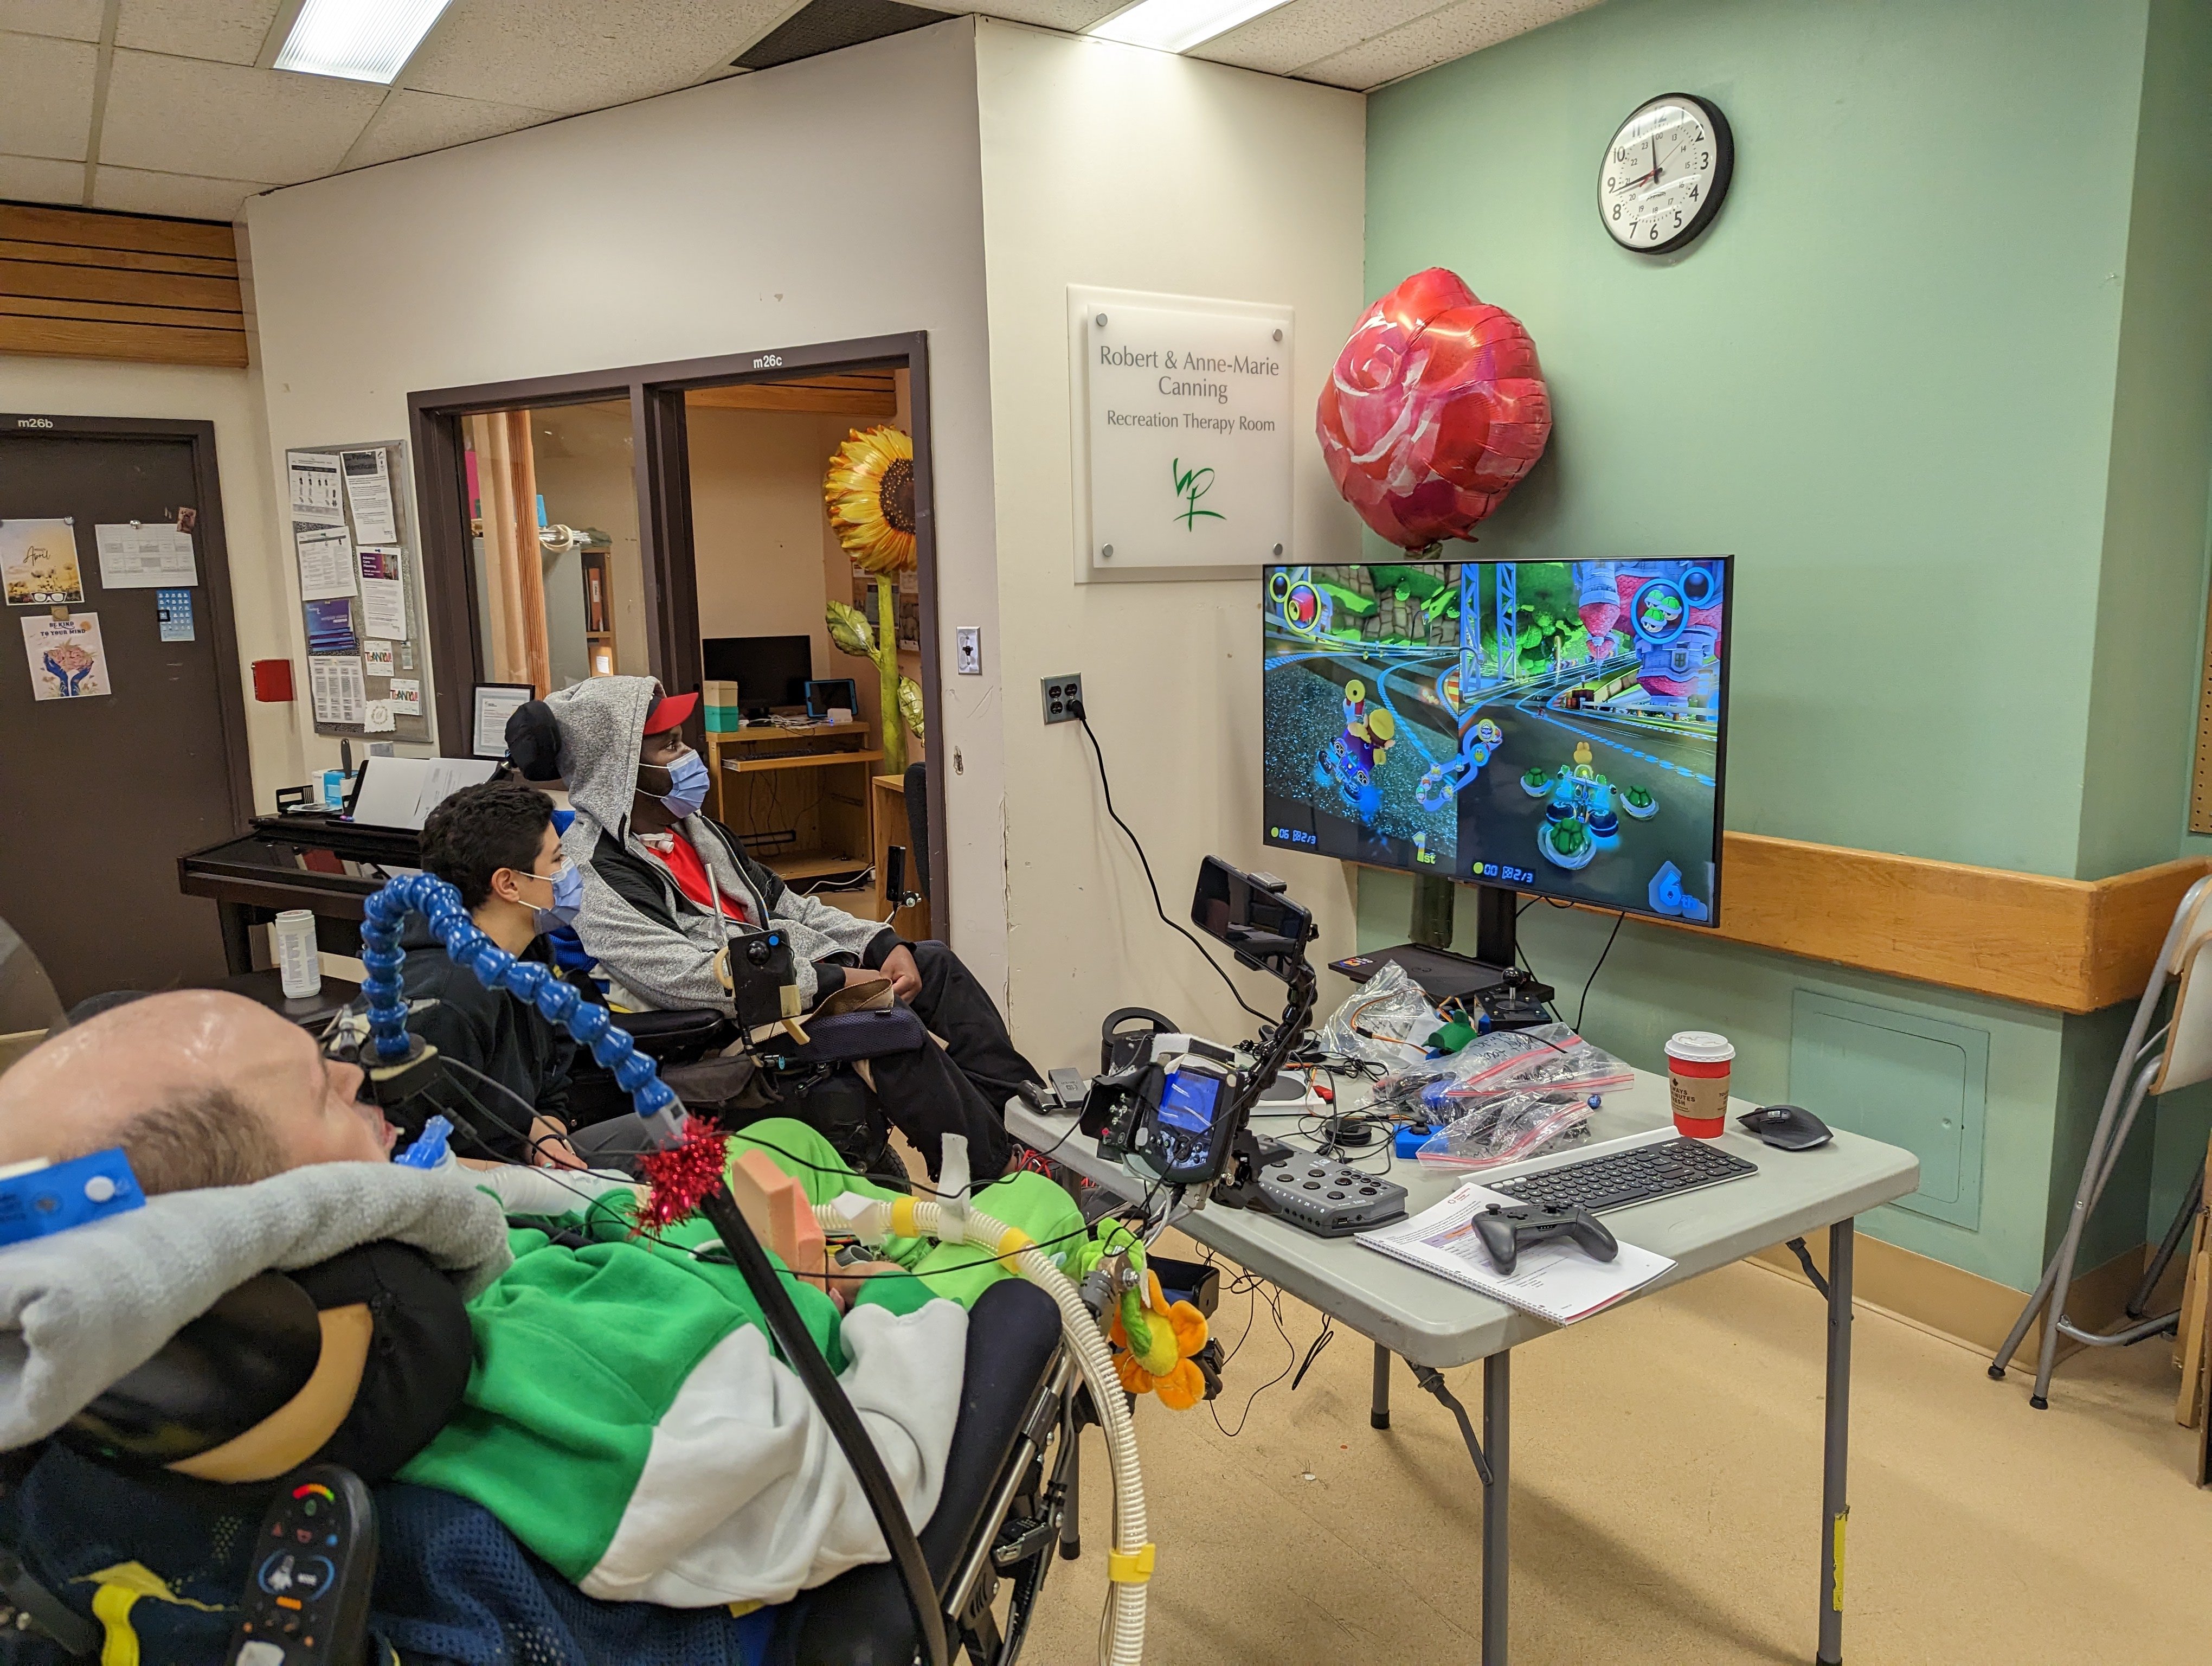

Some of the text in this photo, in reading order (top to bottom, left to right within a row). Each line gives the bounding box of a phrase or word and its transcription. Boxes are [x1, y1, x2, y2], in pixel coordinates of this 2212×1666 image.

[1655, 132, 1663, 140] 00
[1695, 124, 1705, 142] 2
[1613, 145, 1625, 164] 10
[1630, 158, 1638, 166] 22
[1700, 151, 1709, 170] 3
[1684, 161, 1690, 169] 15
[1607, 177, 1616, 194] 9
[1689, 184, 1699, 202] 4
[1629, 193, 1636, 201] 20
[1667, 197, 1674, 206] 17
[1612, 204, 1622, 221] 8
[1673, 210, 1682, 228] 5
[1629, 221, 1639, 239] 7
[1649, 223, 1659, 241] 6
[753, 354, 782, 369] m26c
[1101, 345, 1279, 376] Robert & Anne-Marie
[1158, 376, 1229, 404] Canning
[17, 418, 54, 428] m26b
[1107, 410, 1275, 435] Recreation Therapy Room
[23, 546, 51, 566] April
[1278, 828, 1316, 844] 06 2/3
[1412, 831, 1436, 864] 1st
[1513, 868, 1534, 883] 2/3
[1658, 870, 1699, 909] 6th
